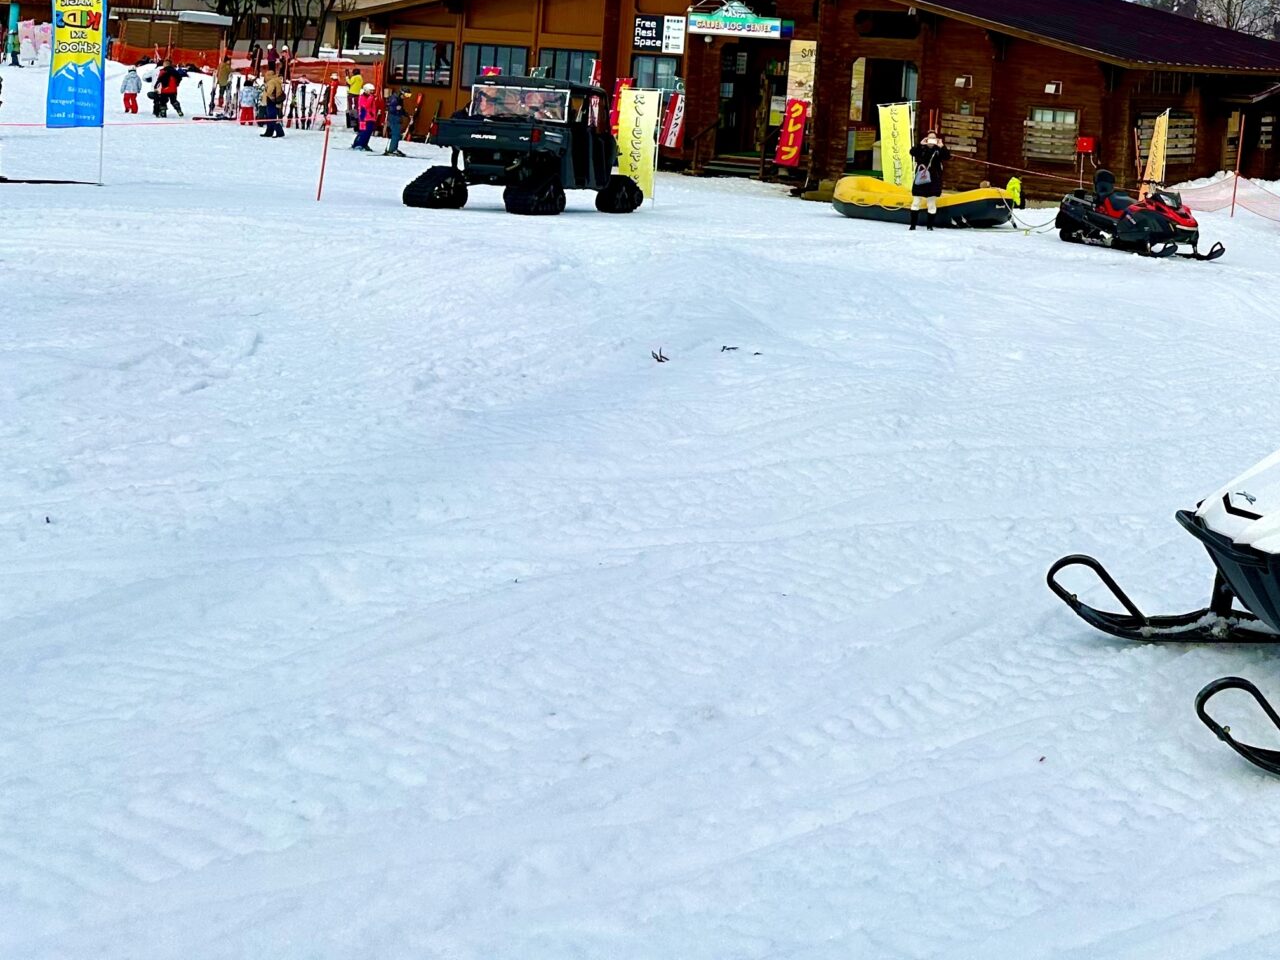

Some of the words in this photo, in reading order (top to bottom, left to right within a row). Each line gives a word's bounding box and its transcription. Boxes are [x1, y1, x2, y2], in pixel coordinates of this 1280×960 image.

[635, 18, 657, 28] Free
[695, 20, 724, 30] GARDEN
[726, 21, 742, 31] LOG
[745, 23, 772, 33] CENTER
[635, 27, 656, 37] Rest
[634, 36, 662, 48] Space
[781, 102, 804, 160] クレープ
